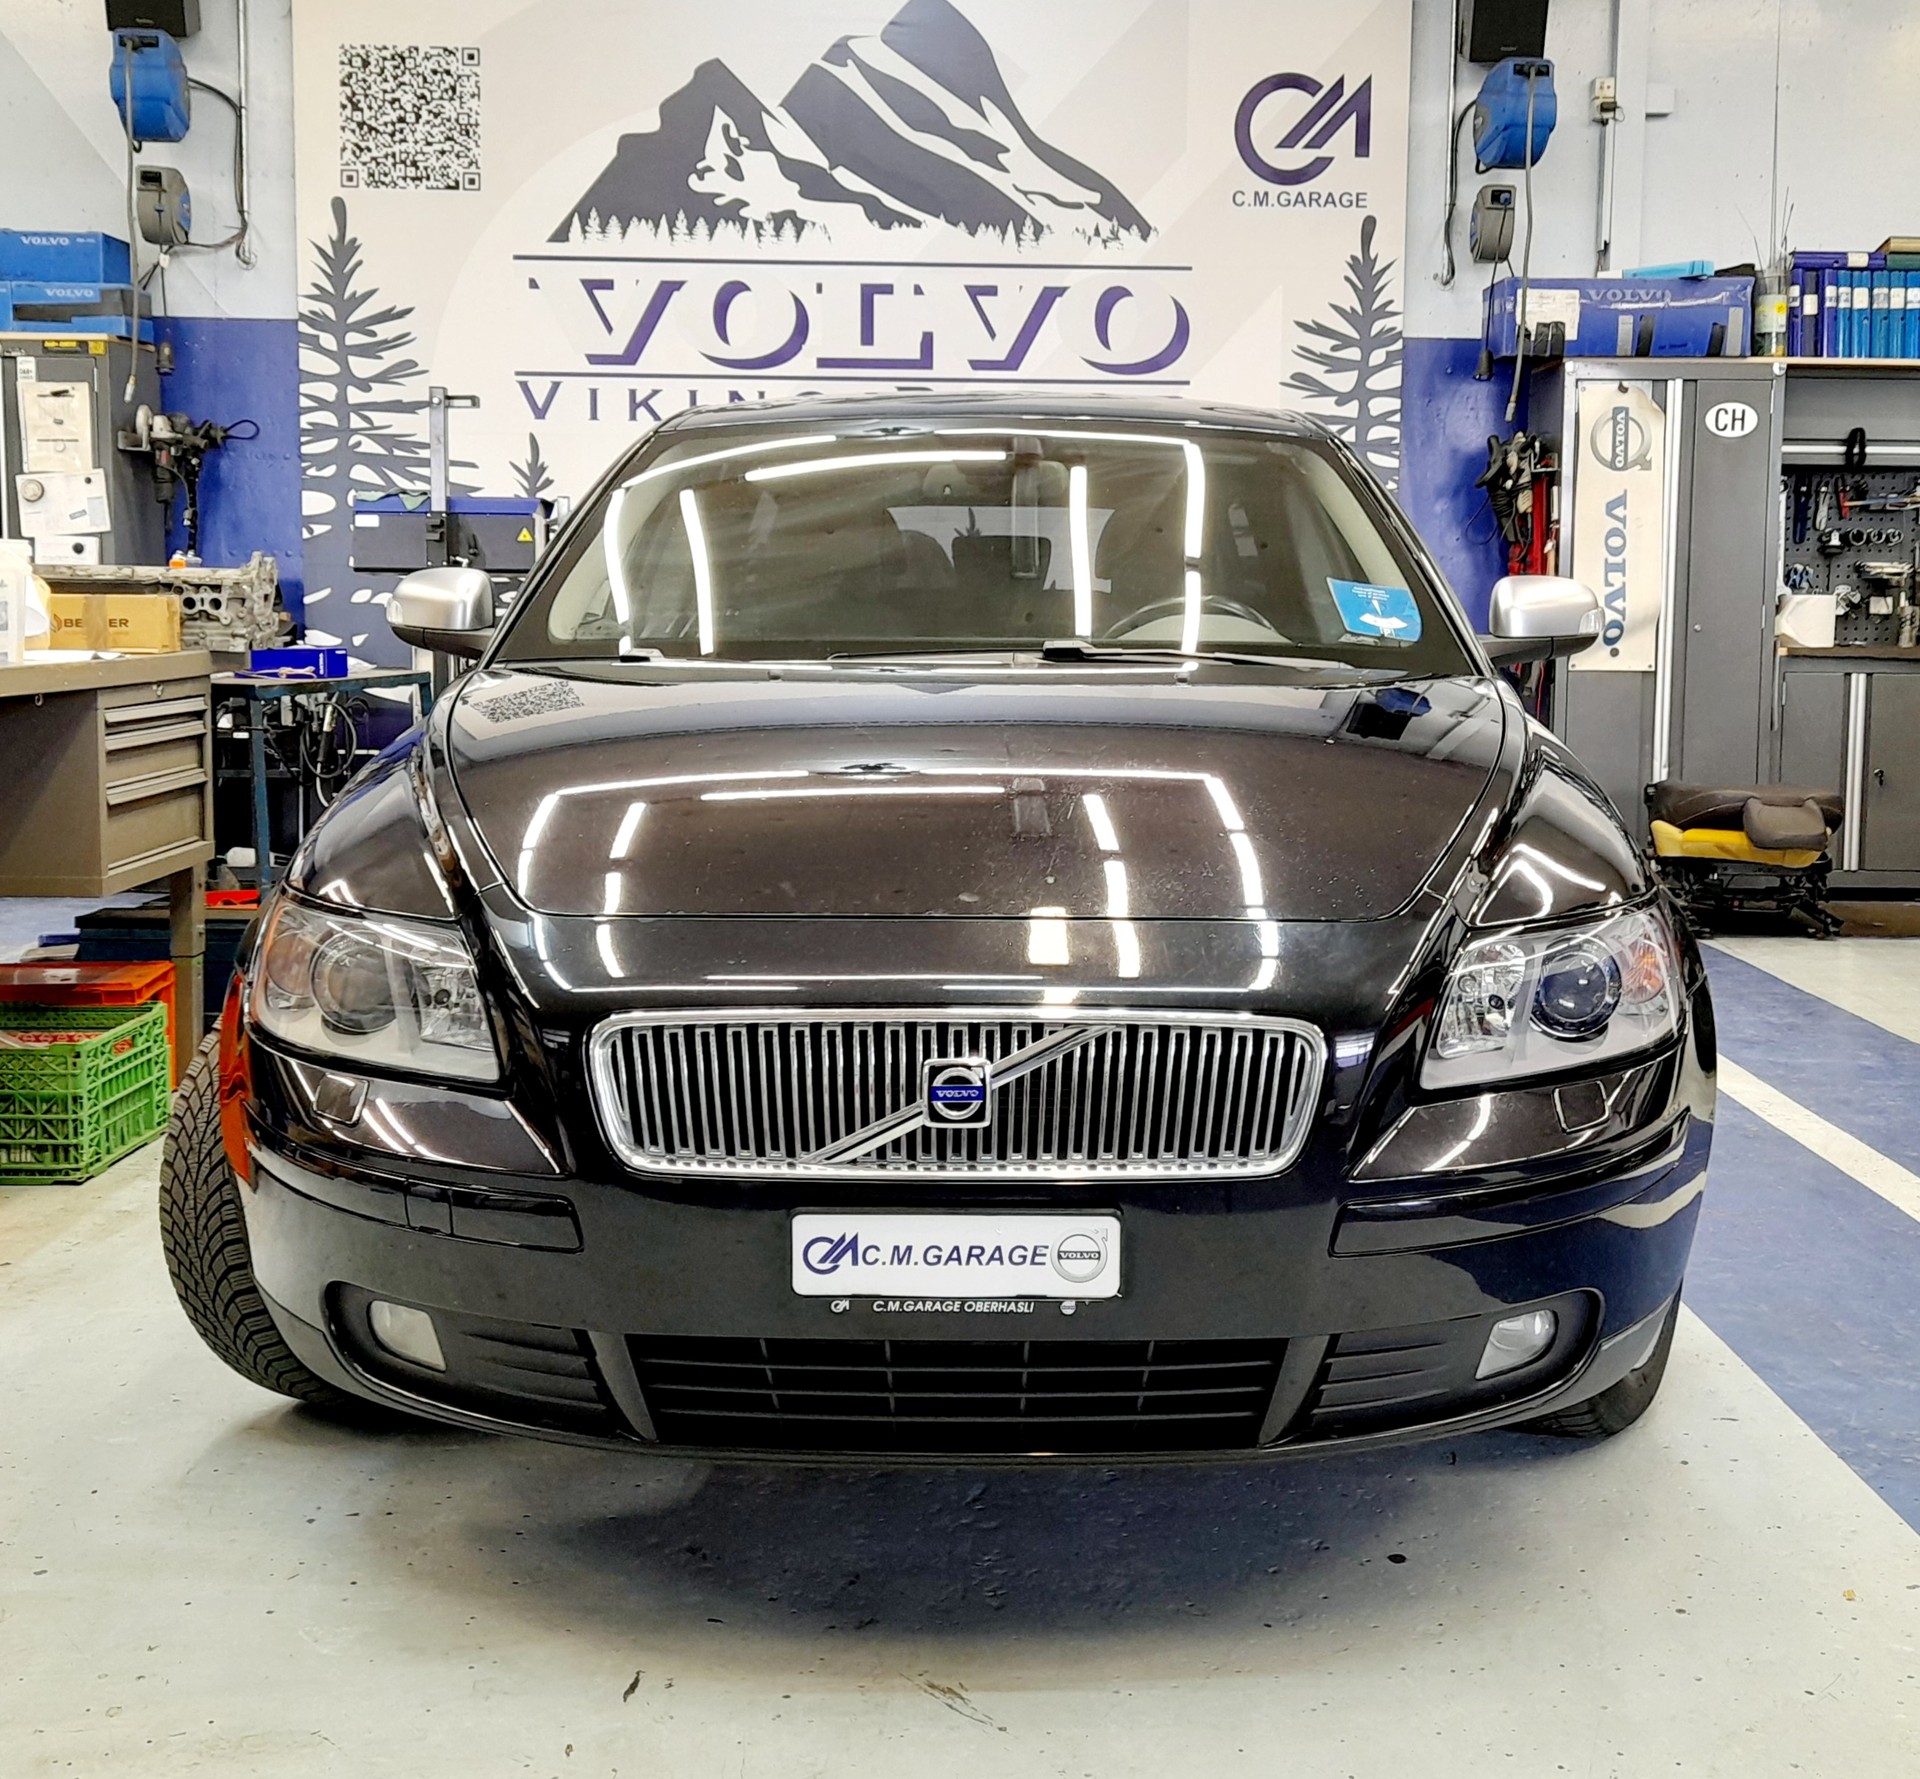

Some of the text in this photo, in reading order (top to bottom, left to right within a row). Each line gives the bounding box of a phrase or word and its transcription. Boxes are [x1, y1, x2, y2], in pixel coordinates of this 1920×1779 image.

[1232, 190, 1368, 209] C.M.GARAGE
[20, 236, 70, 246] VOLVO
[44, 288, 95, 297] VOLVO
[520, 274, 1190, 376] VOLVO
[1715, 408, 1746, 431] CH
[1615, 409, 1627, 468] VOLVO
[1603, 489, 1628, 647] VOLVO
[63, 618, 129, 628] BEER
[936, 1089, 979, 1098] VOLVO
[861, 1244, 1049, 1267] C.M.GARAGE
[1060, 1251, 1100, 1260] VOLVO
[872, 1301, 1034, 1313] C.M.GARAGE OBERHASLI
